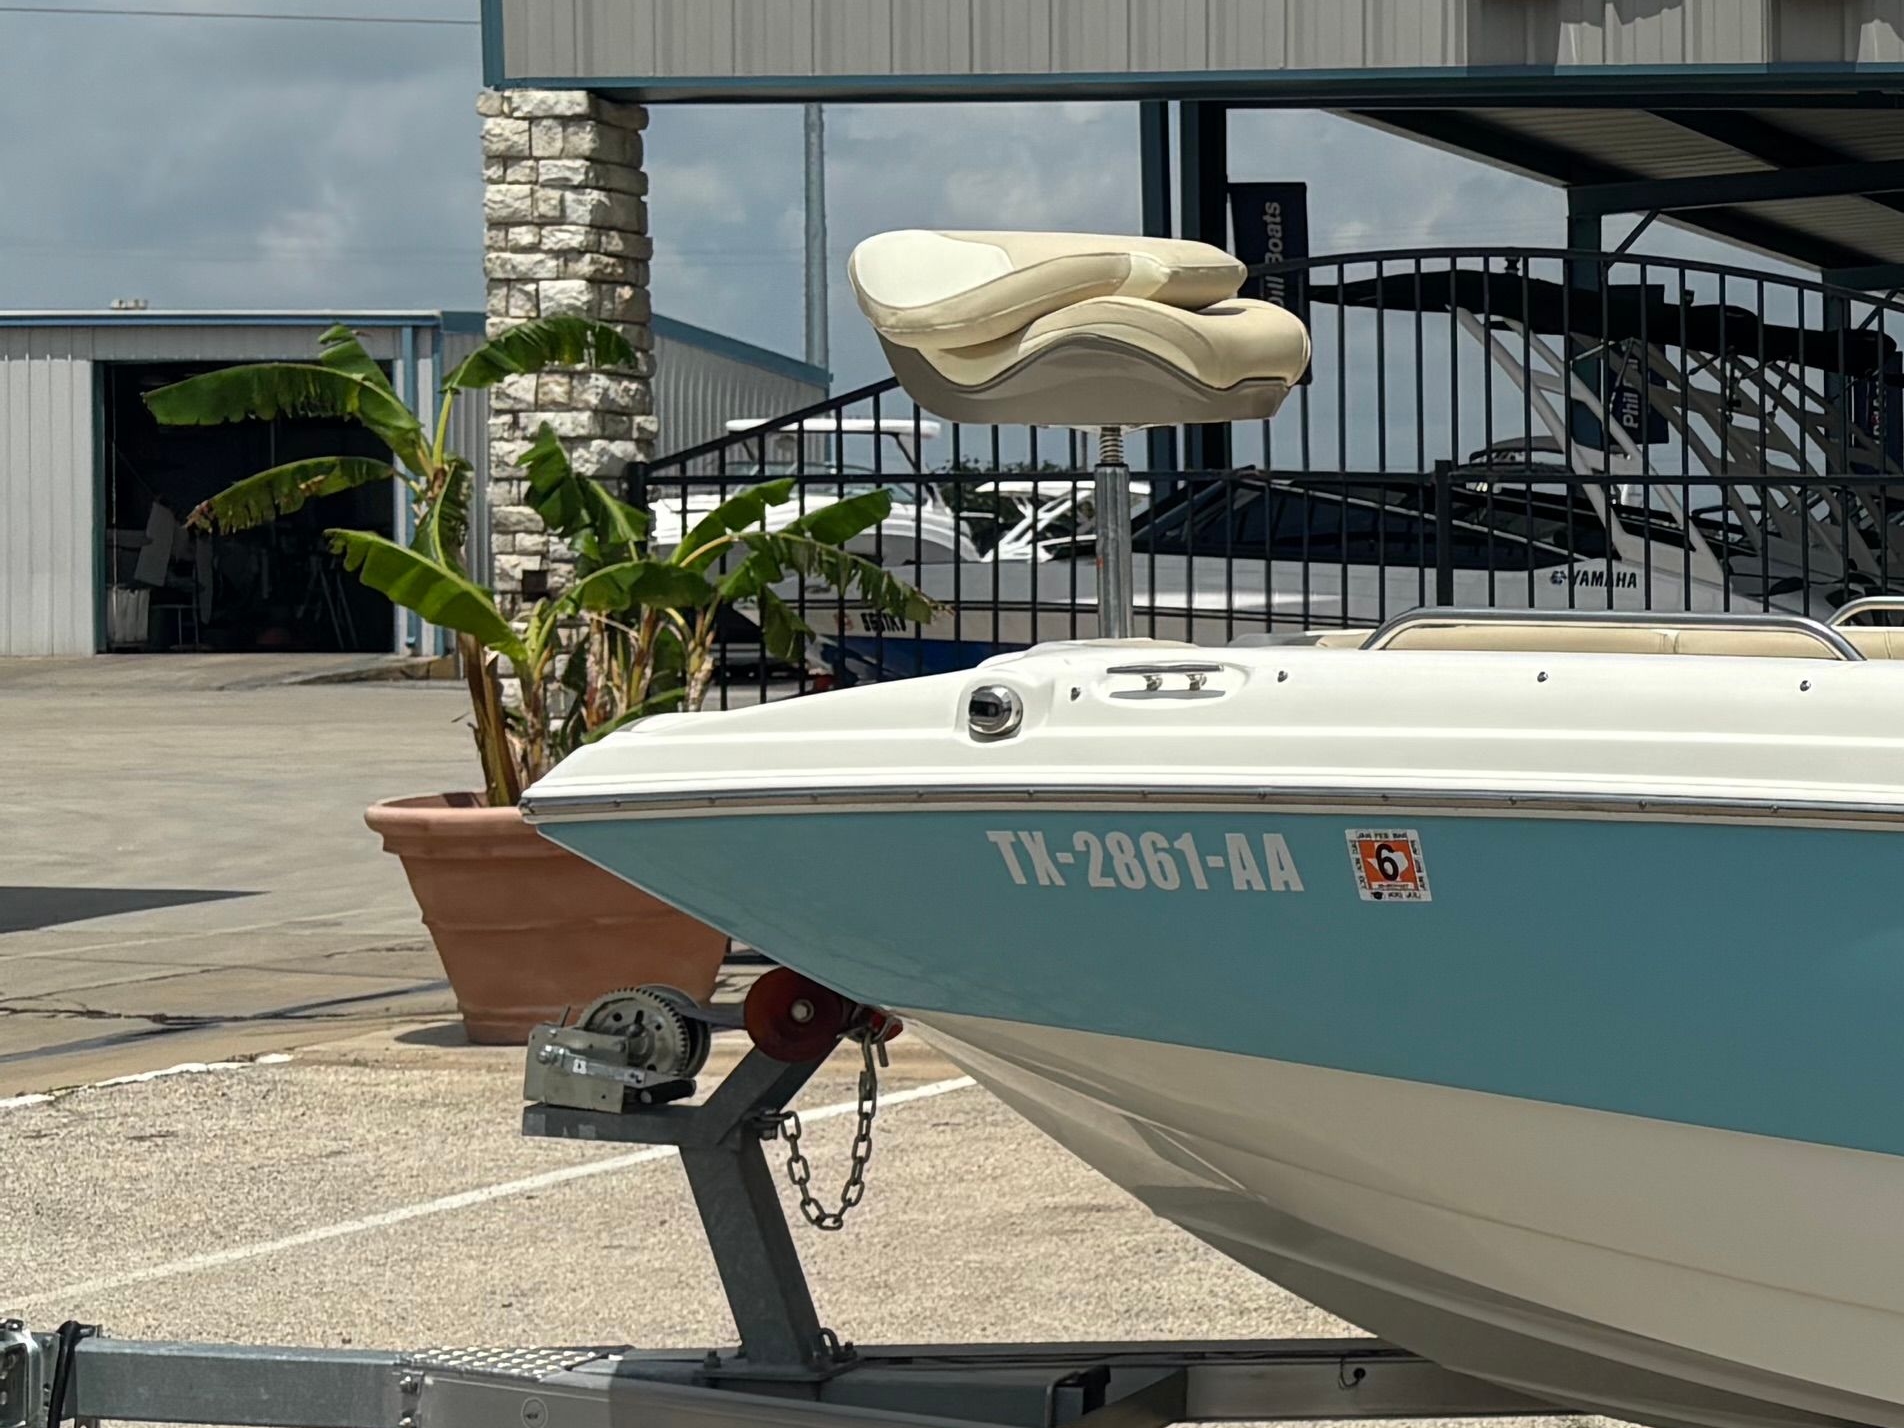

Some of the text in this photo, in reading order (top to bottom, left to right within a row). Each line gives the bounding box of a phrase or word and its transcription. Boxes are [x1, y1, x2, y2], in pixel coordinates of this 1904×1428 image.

[1262, 201, 1284, 265] Boats
[1622, 392, 1640, 429] Phil
[1571, 570, 1637, 589] YAMHA
[985, 830, 1305, 892] TX-2861-AA
[1375, 843, 1399, 882] 6
